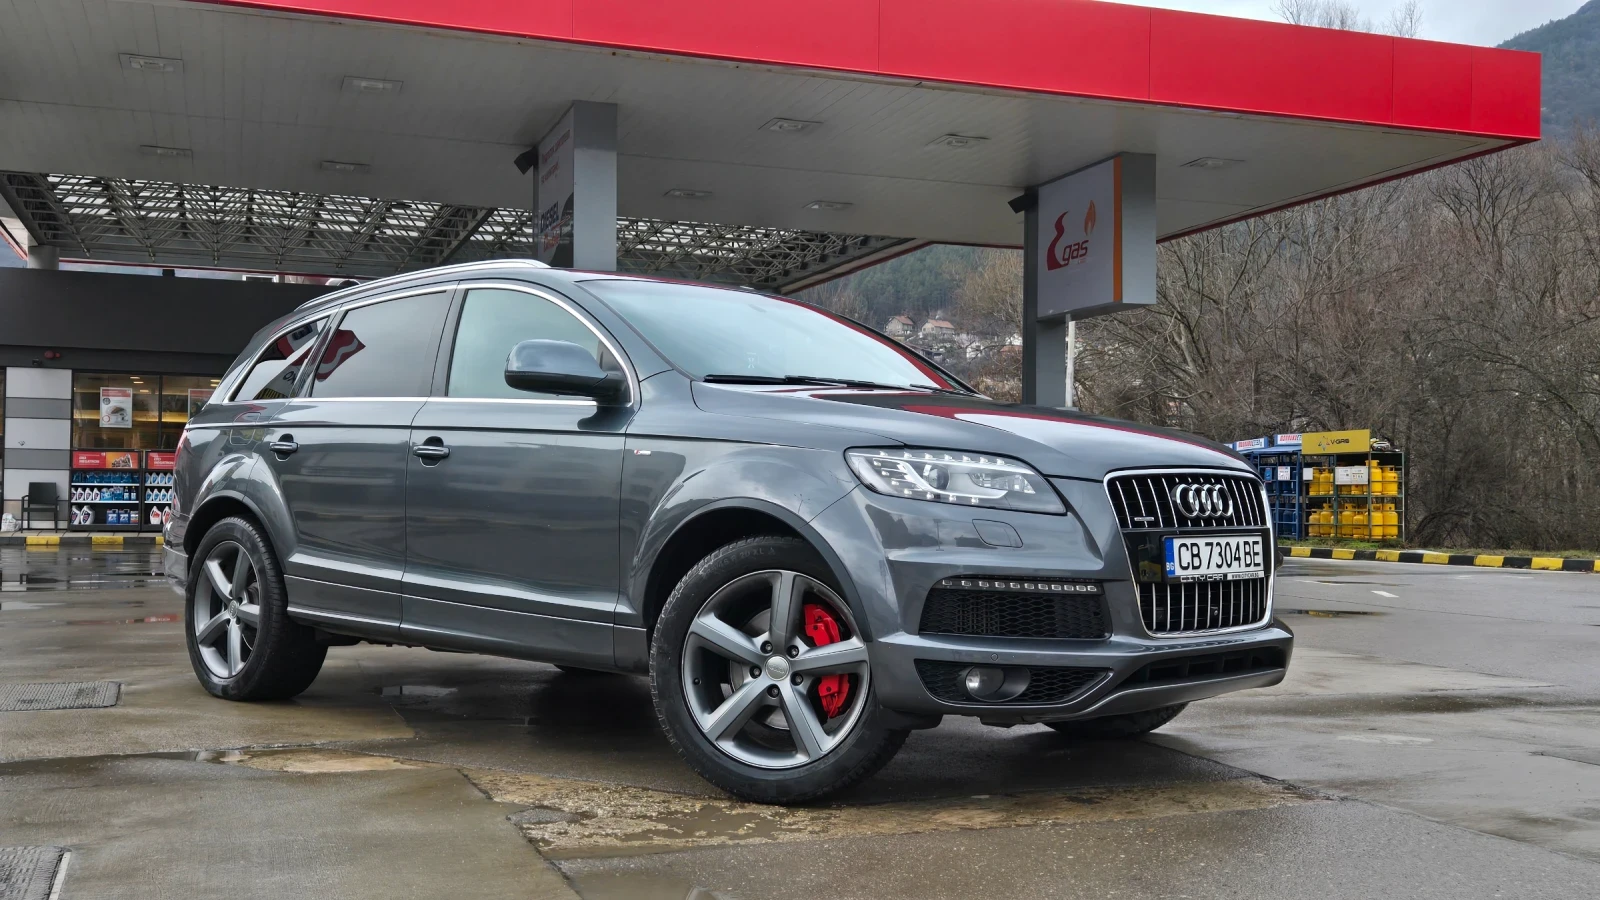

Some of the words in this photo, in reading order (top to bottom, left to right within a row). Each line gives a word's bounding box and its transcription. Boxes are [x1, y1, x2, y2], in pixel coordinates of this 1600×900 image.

[1178, 542, 1202, 571] CB
[1205, 541, 1241, 570] 7304
[1243, 541, 1261, 568] BE
[1166, 562, 1175, 571] BG
[1180, 574, 1205, 582] CITY
[1207, 573, 1224, 581] CAR
